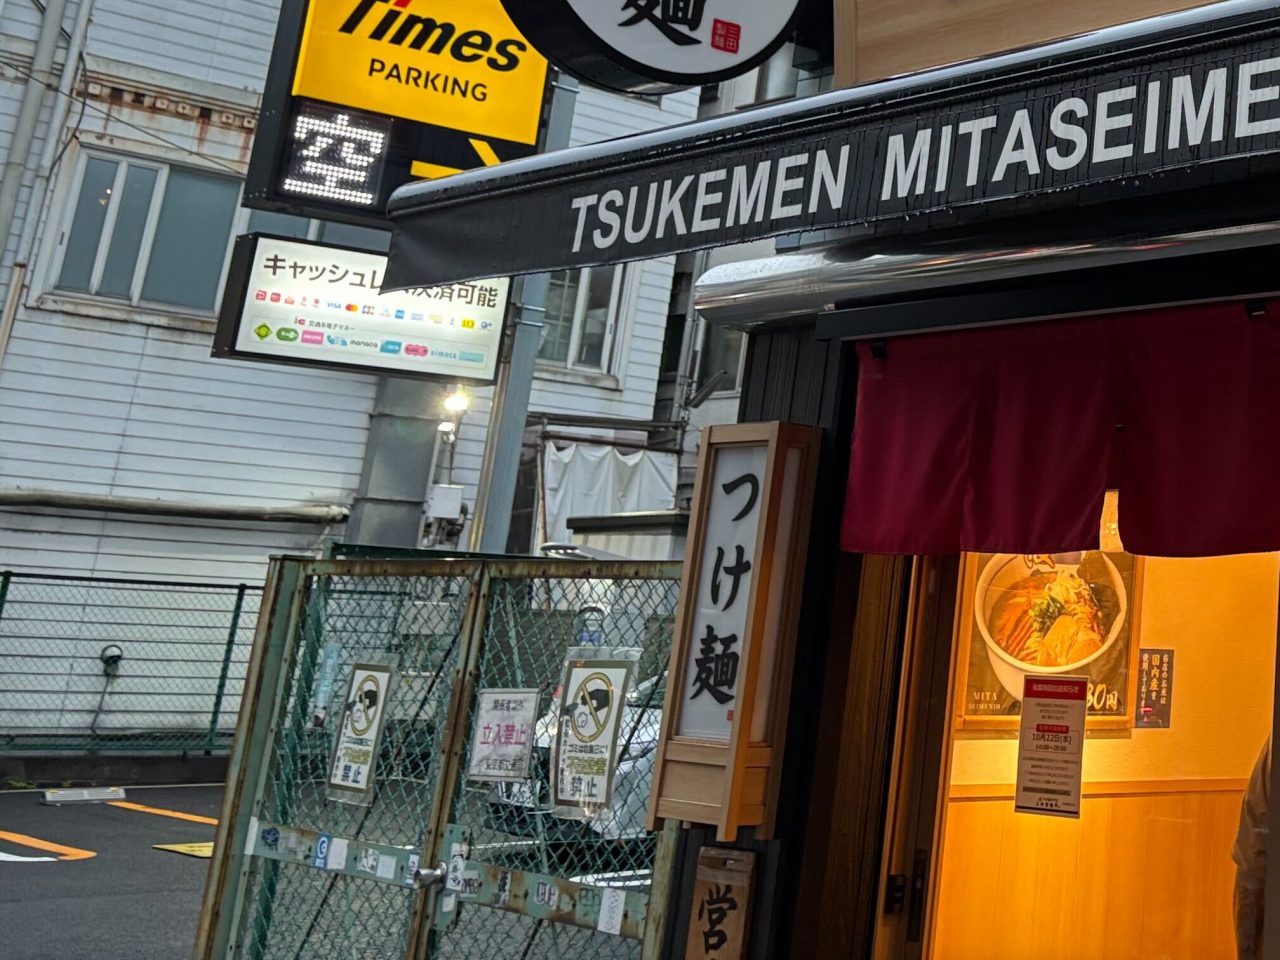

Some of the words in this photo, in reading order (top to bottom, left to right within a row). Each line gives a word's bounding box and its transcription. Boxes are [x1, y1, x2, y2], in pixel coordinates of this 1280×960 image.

[367, 58, 488, 102] PARKING
[283, 113, 385, 205] 空
[571, 143, 851, 253] TSUKEMEN
[263, 254, 498, 309] キャッシュレ済可能
[689, 472, 760, 705] つけ麺
[973, 691, 998, 701] MITA
[480, 723, 528, 746] 立入禁止
[698, 883, 739, 960] 営
